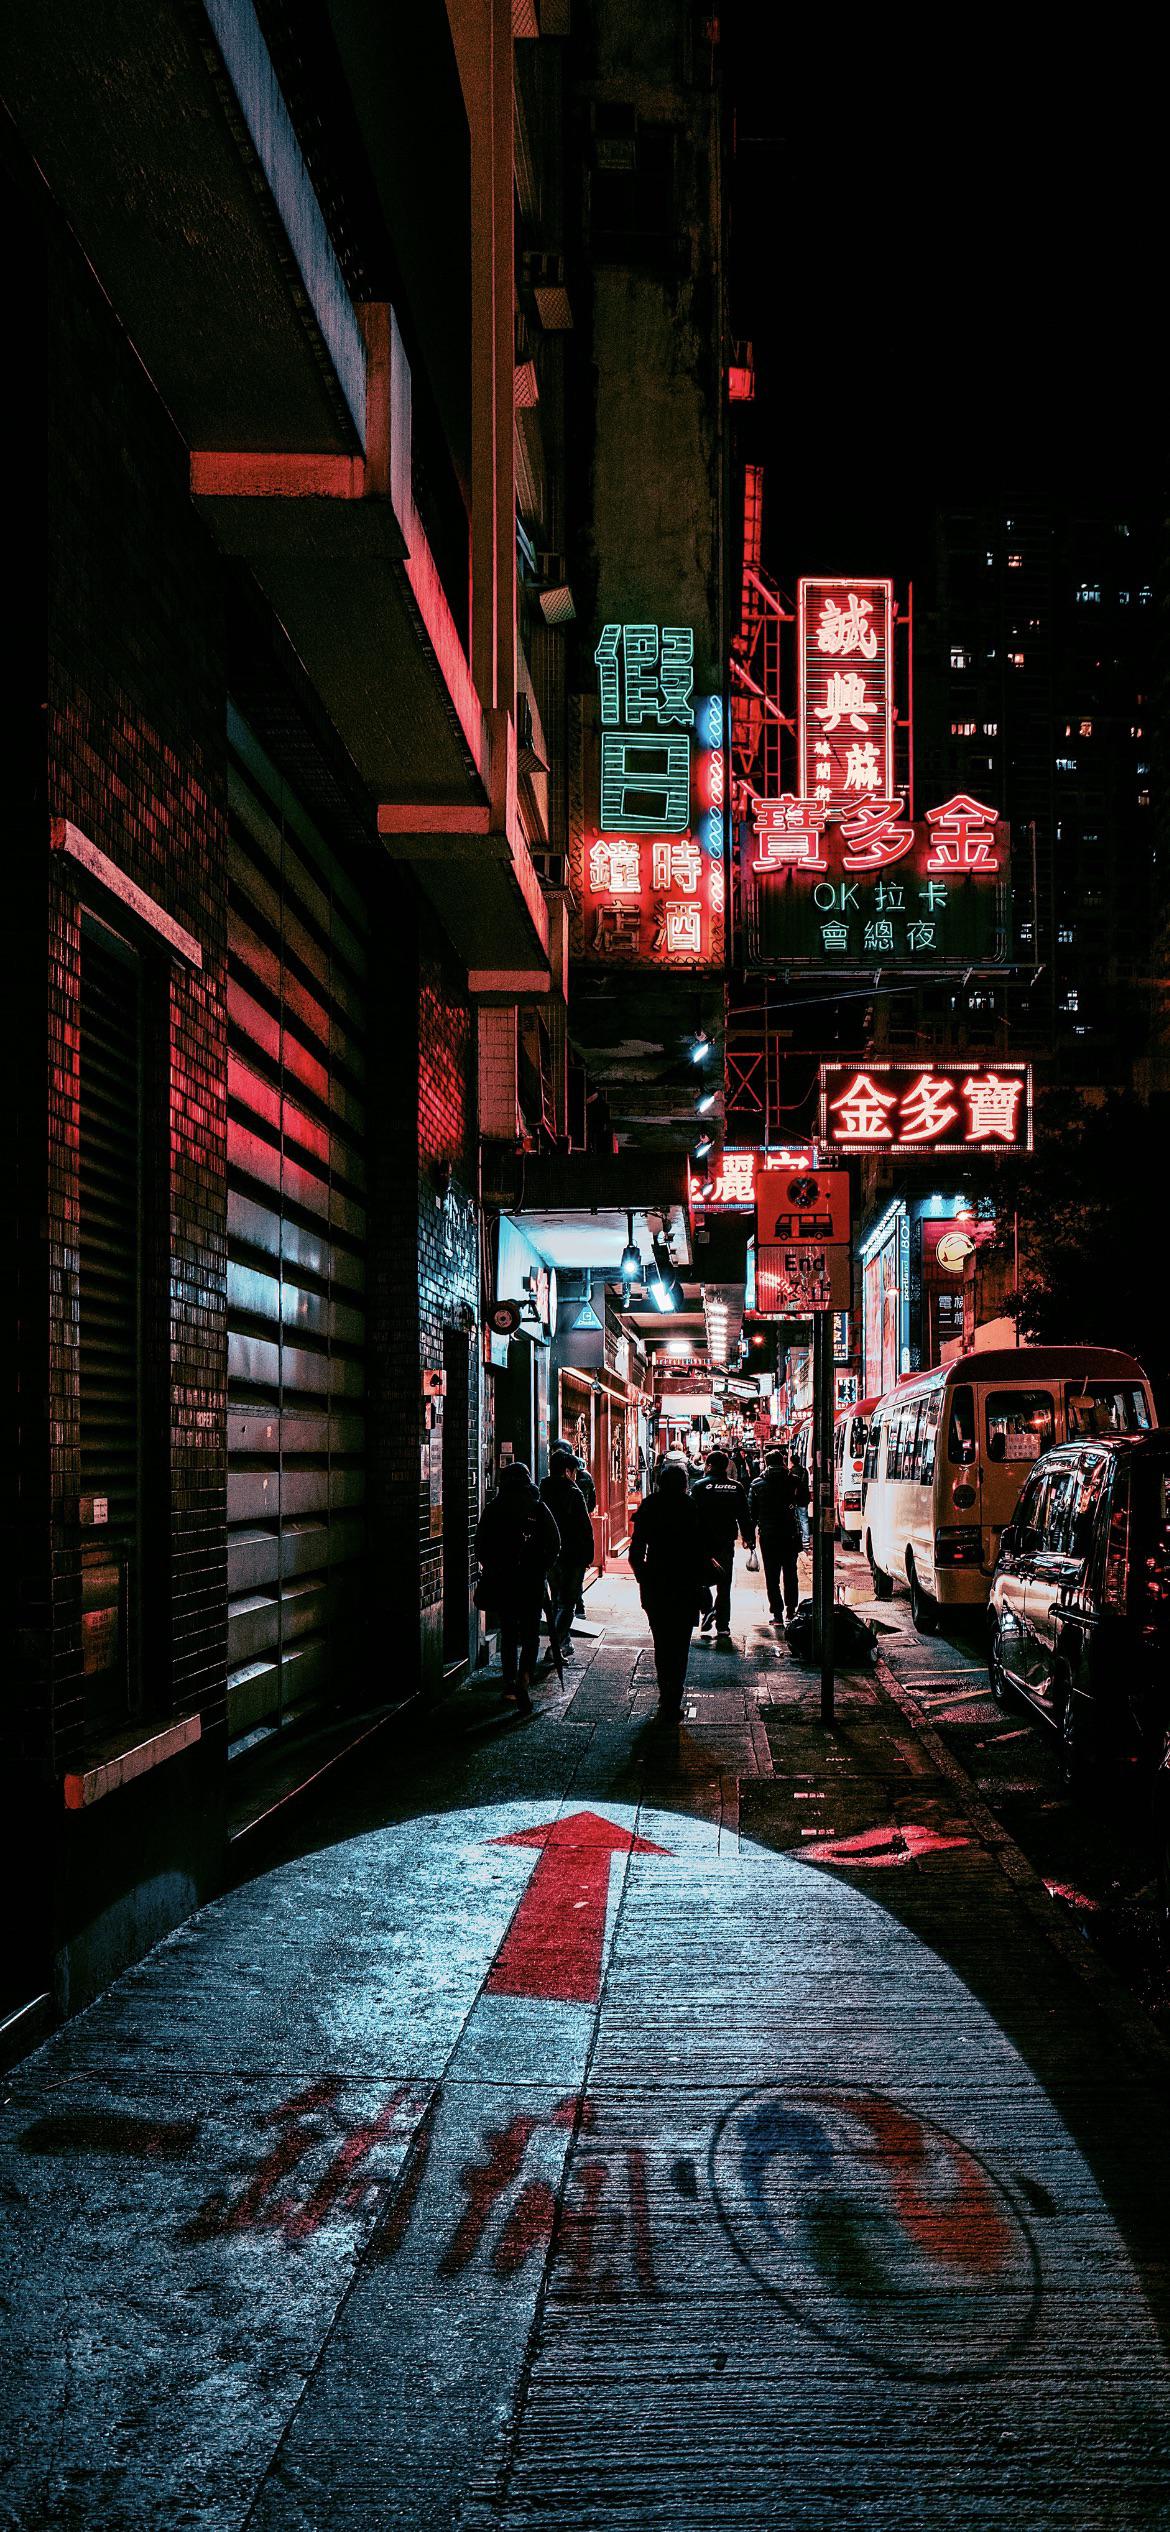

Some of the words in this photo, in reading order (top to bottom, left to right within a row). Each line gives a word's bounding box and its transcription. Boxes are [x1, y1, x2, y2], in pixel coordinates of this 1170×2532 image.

[594, 623, 696, 833] 假日
[828, 1073, 1024, 1144] 金多寶
[784, 1253, 826, 1272] End
[902, 1260, 911, 1301] portland
